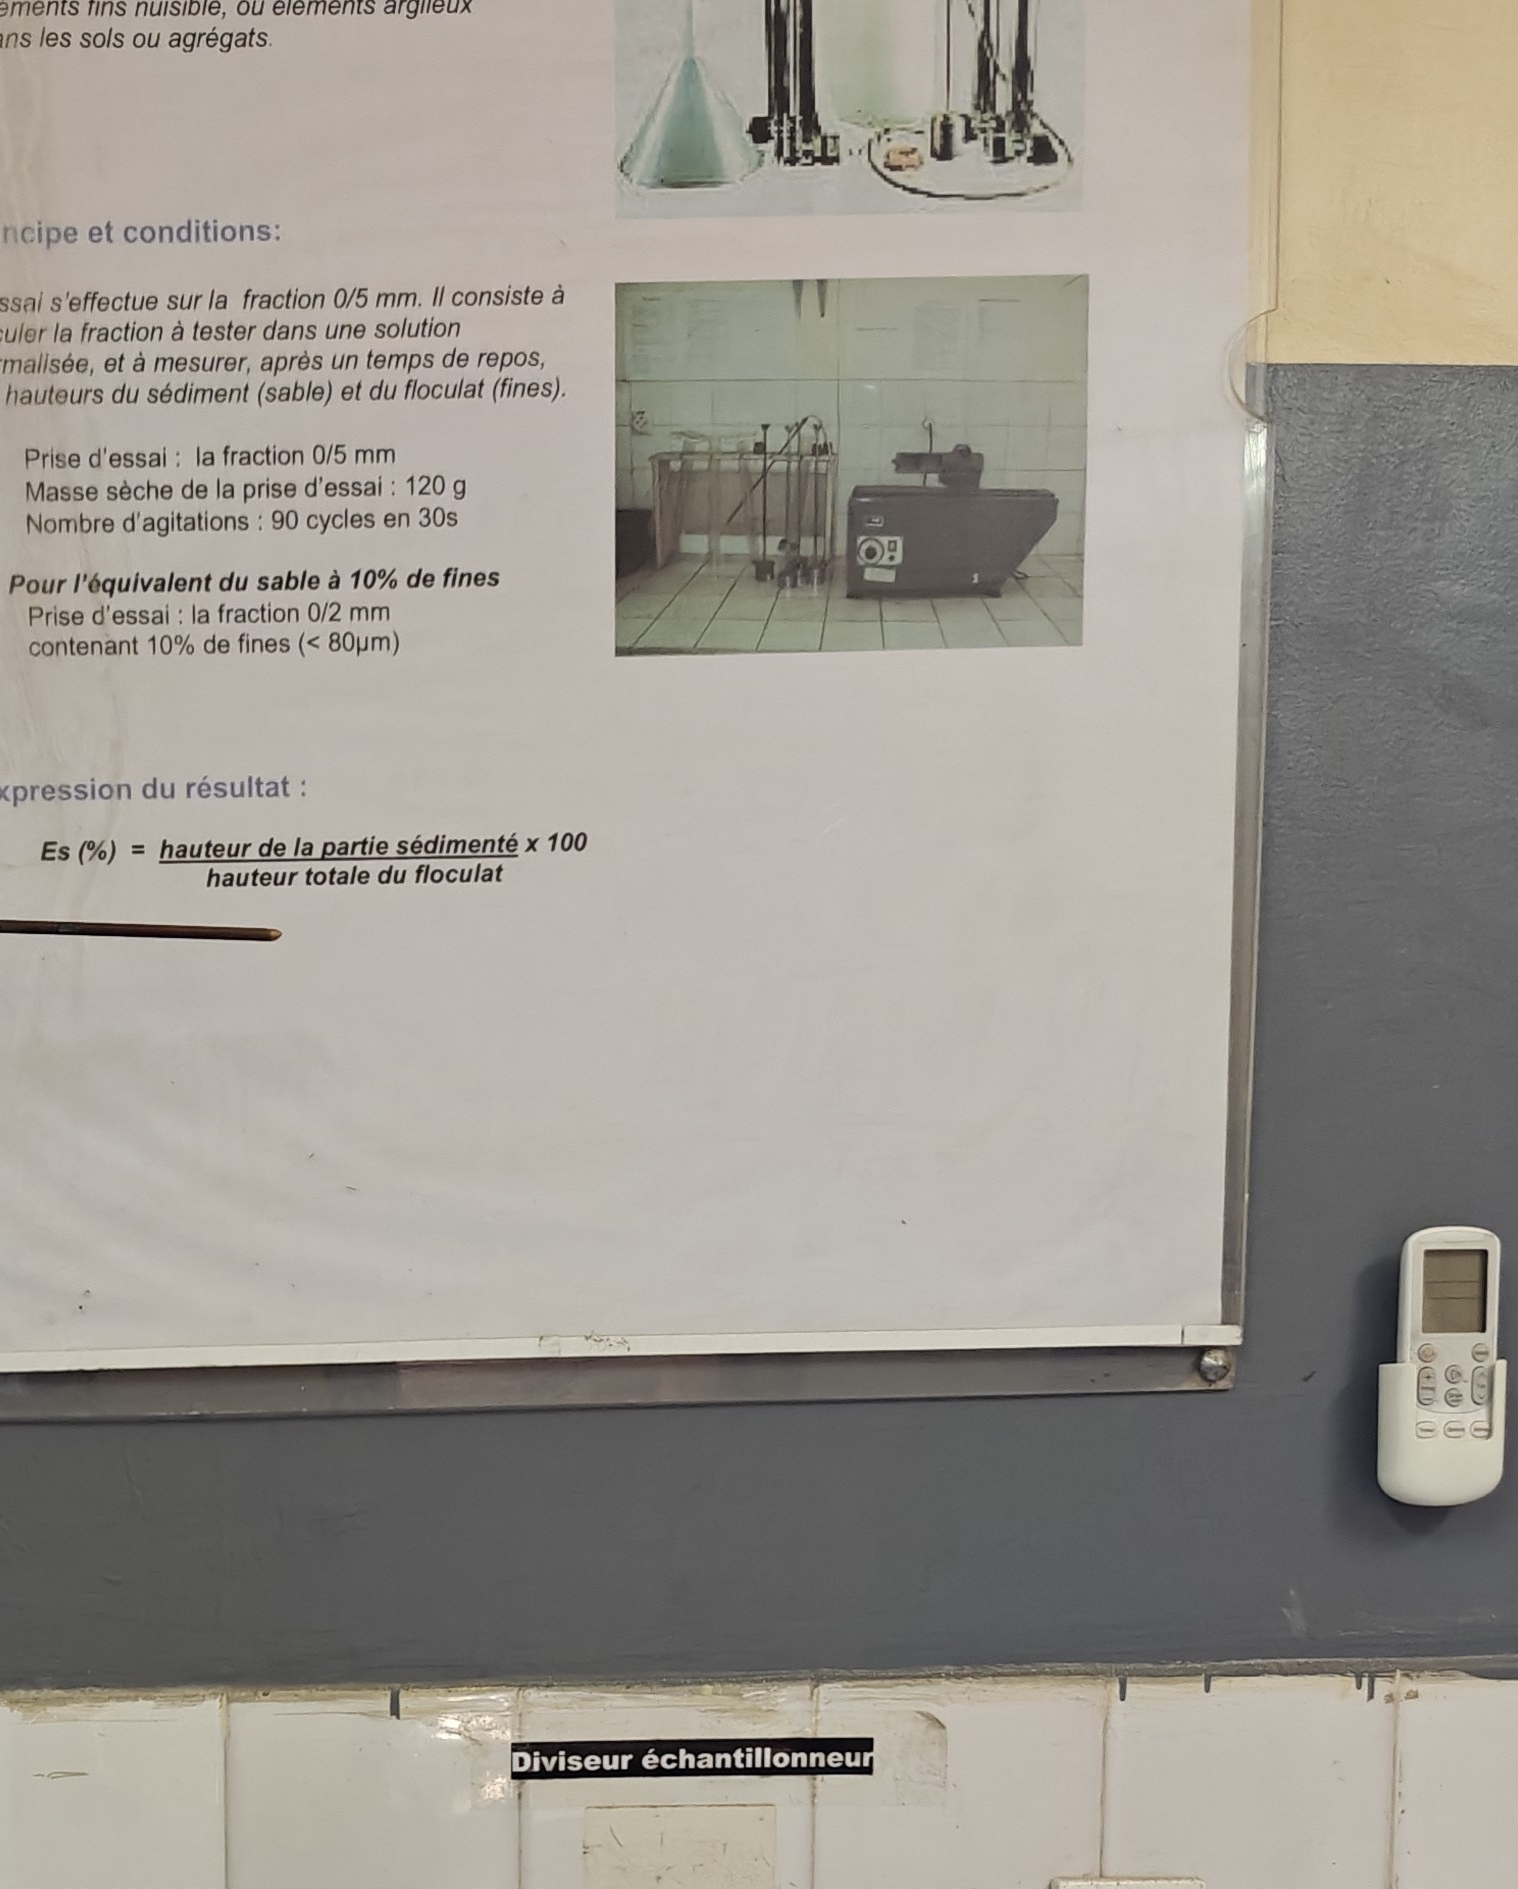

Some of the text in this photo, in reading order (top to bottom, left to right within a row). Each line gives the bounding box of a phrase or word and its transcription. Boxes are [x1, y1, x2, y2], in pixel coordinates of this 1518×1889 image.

[236, 0, 265, 16] ou
[39, 26, 72, 48] les
[79, 27, 125, 48] sols
[132, 32, 161, 48] ou
[168, 26, 272, 53] agrégats.
[88, 220, 113, 244] et
[123, 219, 280, 244] conditions:
[50, 291, 158, 314] s'effectue
[167, 293, 203, 312] sur
[208, 288, 227, 311] la
[243, 288, 325, 311] fraction
[333, 287, 368, 309] 0/5
[375, 292, 422, 308] mm.
[432, 285, 445, 307] Il
[452, 284, 544, 307] consiste
[552, 284, 565, 305] à
[54, 322, 72, 343] la
[80, 320, 163, 344] fraction
[171, 320, 184, 342] à
[192, 320, 257, 341] tester
[263, 318, 317, 341] dans
[325, 322, 366, 340] une
[374, 315, 461, 339] solution
[104, 353, 125, 373] et
[132, 351, 145, 373] à
[154, 355, 250, 376] mesurer,
[260, 349, 323, 377] après
[331, 353, 359, 371] un
[367, 348, 435, 375] temps
[442, 347, 469, 368] de
[477, 351, 544, 373] repos,
[6, 383, 104, 406] hauteurs
[112, 382, 139, 404] du
[147, 381, 249, 405] sédiment
[258, 379, 332, 408] (sable)
[341, 379, 362, 401] et
[369, 379, 397, 401] du
[404, 377, 485, 400] floculat
[492, 376, 566, 404] (fines).
[25, 447, 81, 470] Prise
[89, 446, 166, 469] d'essai
[197, 446, 215, 467] la
[222, 444, 304, 467] fraction
[313, 443, 347, 465] 0/5
[355, 448, 395, 465] mm
[26, 480, 99, 503] Masse
[107, 479, 173, 501] sèche
[181, 477, 208, 500] de
[217, 477, 235, 500] la
[243, 477, 297, 504] prise
[304, 475, 382, 498] d'essai
[406, 474, 445, 496] 120
[453, 479, 466, 500] g
[26, 512, 115, 536] Nombre
[122, 509, 249, 538] d'agitations
[272, 509, 299, 530] 90
[306, 507, 375, 535] cycles
[383, 512, 410, 528] en
[419, 506, 458, 528] 30s
[9, 567, 500, 599] Pour l'équivalent du sable à 10% de fines
[29, 605, 84, 627] Prise
[92, 603, 169, 627] d'essai
[192, 603, 210, 625] la
[218, 601, 299, 624] fraction
[308, 601, 341, 623] 0/2
[350, 605, 390, 624] mm
[29, 630, 399, 658] contenant 10% de fines (< 80µm)
[142, 777, 175, 800] du
[186, 775, 290, 799] résultat
[41, 841, 70, 861] Es
[78, 839, 116, 866] (%)
[159, 839, 251, 859] hauteur
[258, 838, 286, 857] de
[293, 837, 313, 857] la
[321, 836, 390, 861] partie
[395, 832, 519, 855] sédimenté
[524, 837, 540, 853] x
[547, 832, 588, 853] 100
[206, 863, 504, 888] hauteur totale du floculat
[512, 1747, 874, 1773] Diviseur échantillonneur
